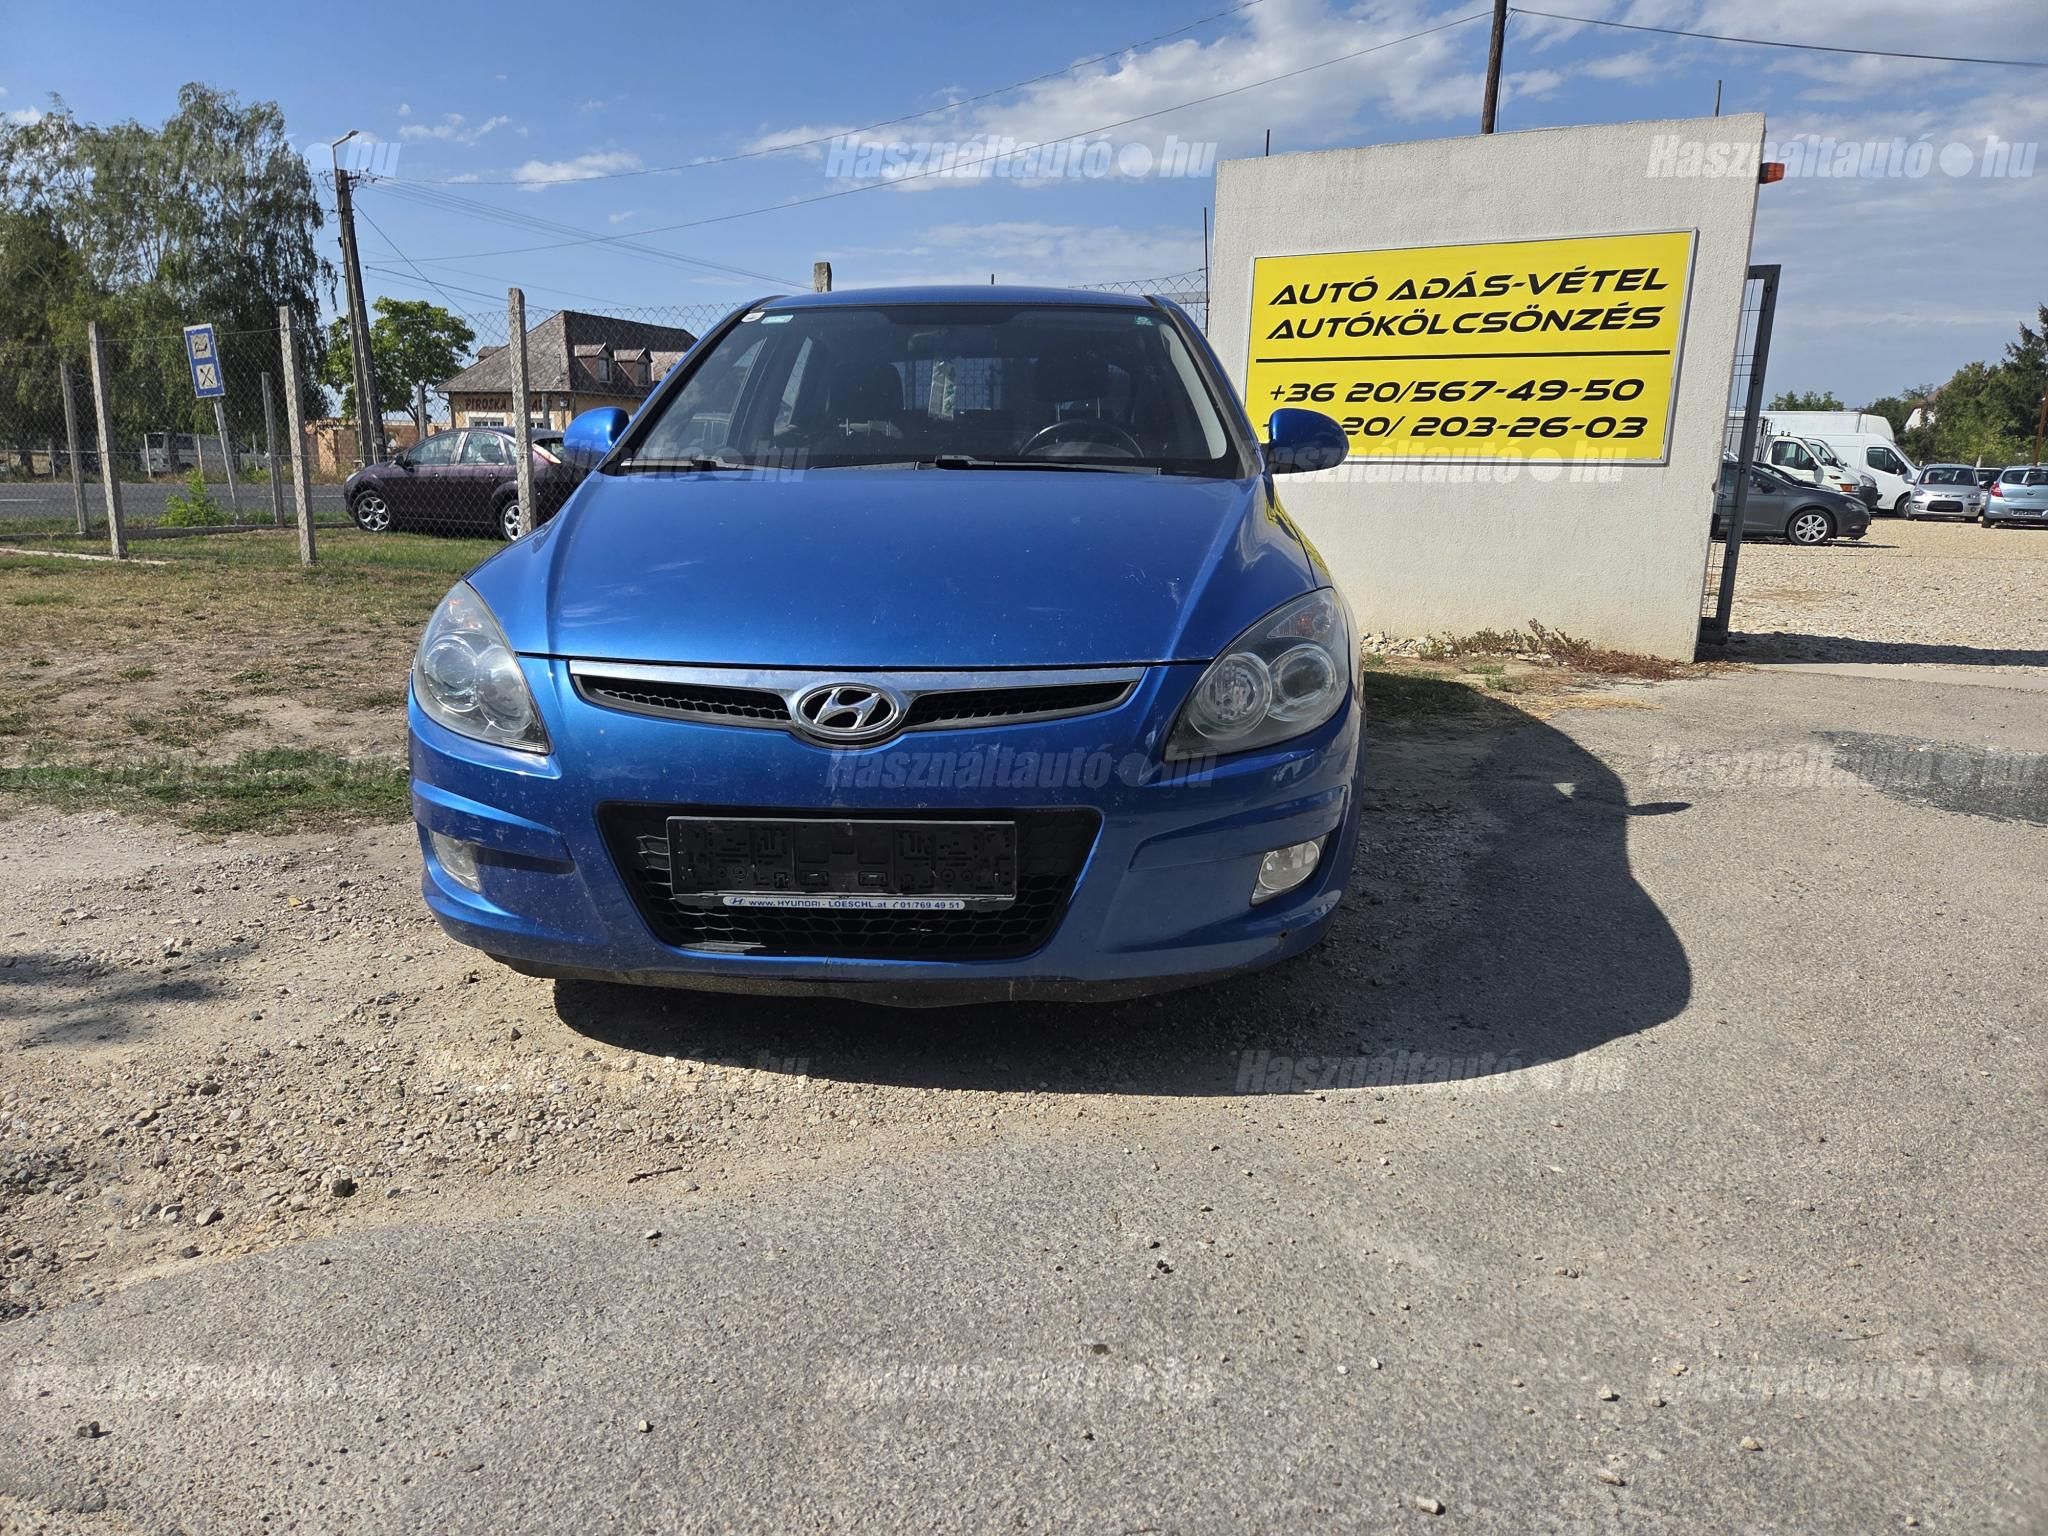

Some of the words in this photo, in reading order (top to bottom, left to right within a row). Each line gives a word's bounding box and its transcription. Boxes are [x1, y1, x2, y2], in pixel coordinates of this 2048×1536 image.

[1269, 276, 1379, 305] AUTÓ
[1386, 265, 1669, 301] ADÁS-VÉTEL
[1266, 301, 1666, 340] AUTÓKÖLCSÖNZÉS
[1270, 382, 1337, 403] +36
[1345, 378, 1645, 404] 20/567-49-50
[1410, 416, 1648, 439] 203-26-03
[934, 901, 946, 909] 49
[949, 901, 960, 909] 51
